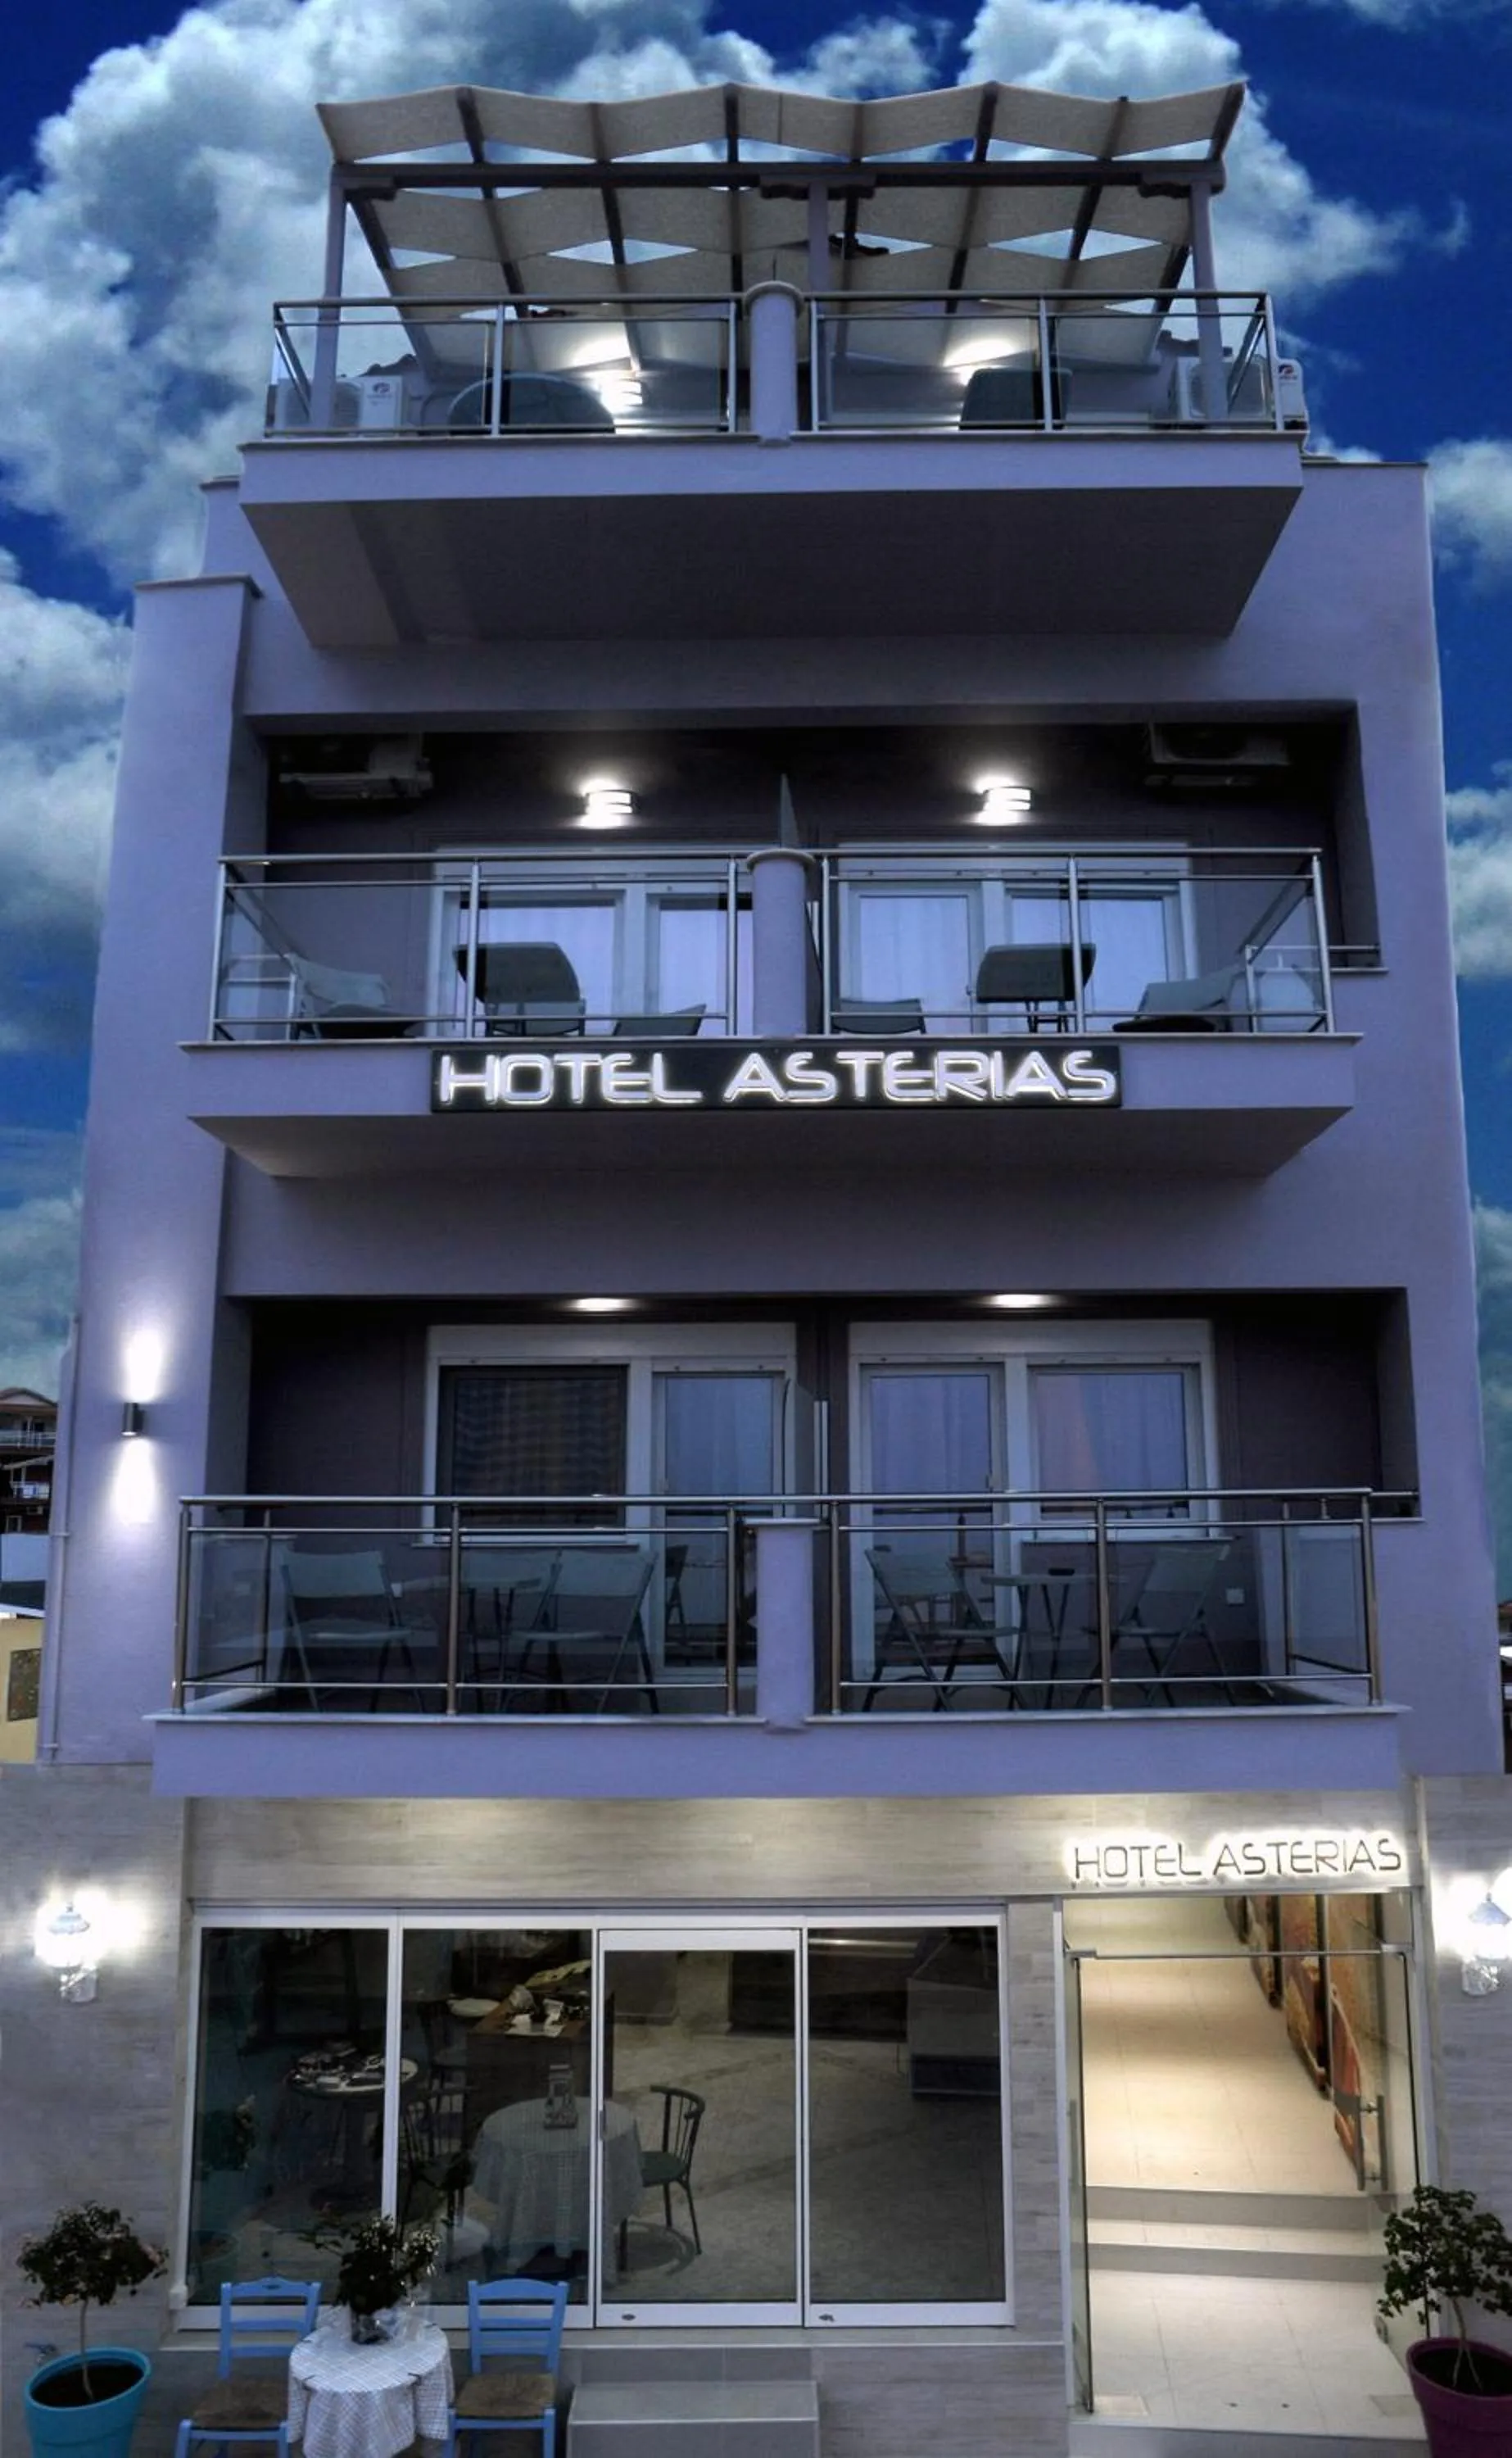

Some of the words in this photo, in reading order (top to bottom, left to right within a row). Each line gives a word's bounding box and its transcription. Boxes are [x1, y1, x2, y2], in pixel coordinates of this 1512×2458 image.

[439, 1052, 703, 1104] HOTEL
[723, 1050, 1118, 1103] ASTERIAS
[1074, 1843, 1202, 1879] HOTEL
[1212, 1838, 1401, 1875] ASTERIAS
